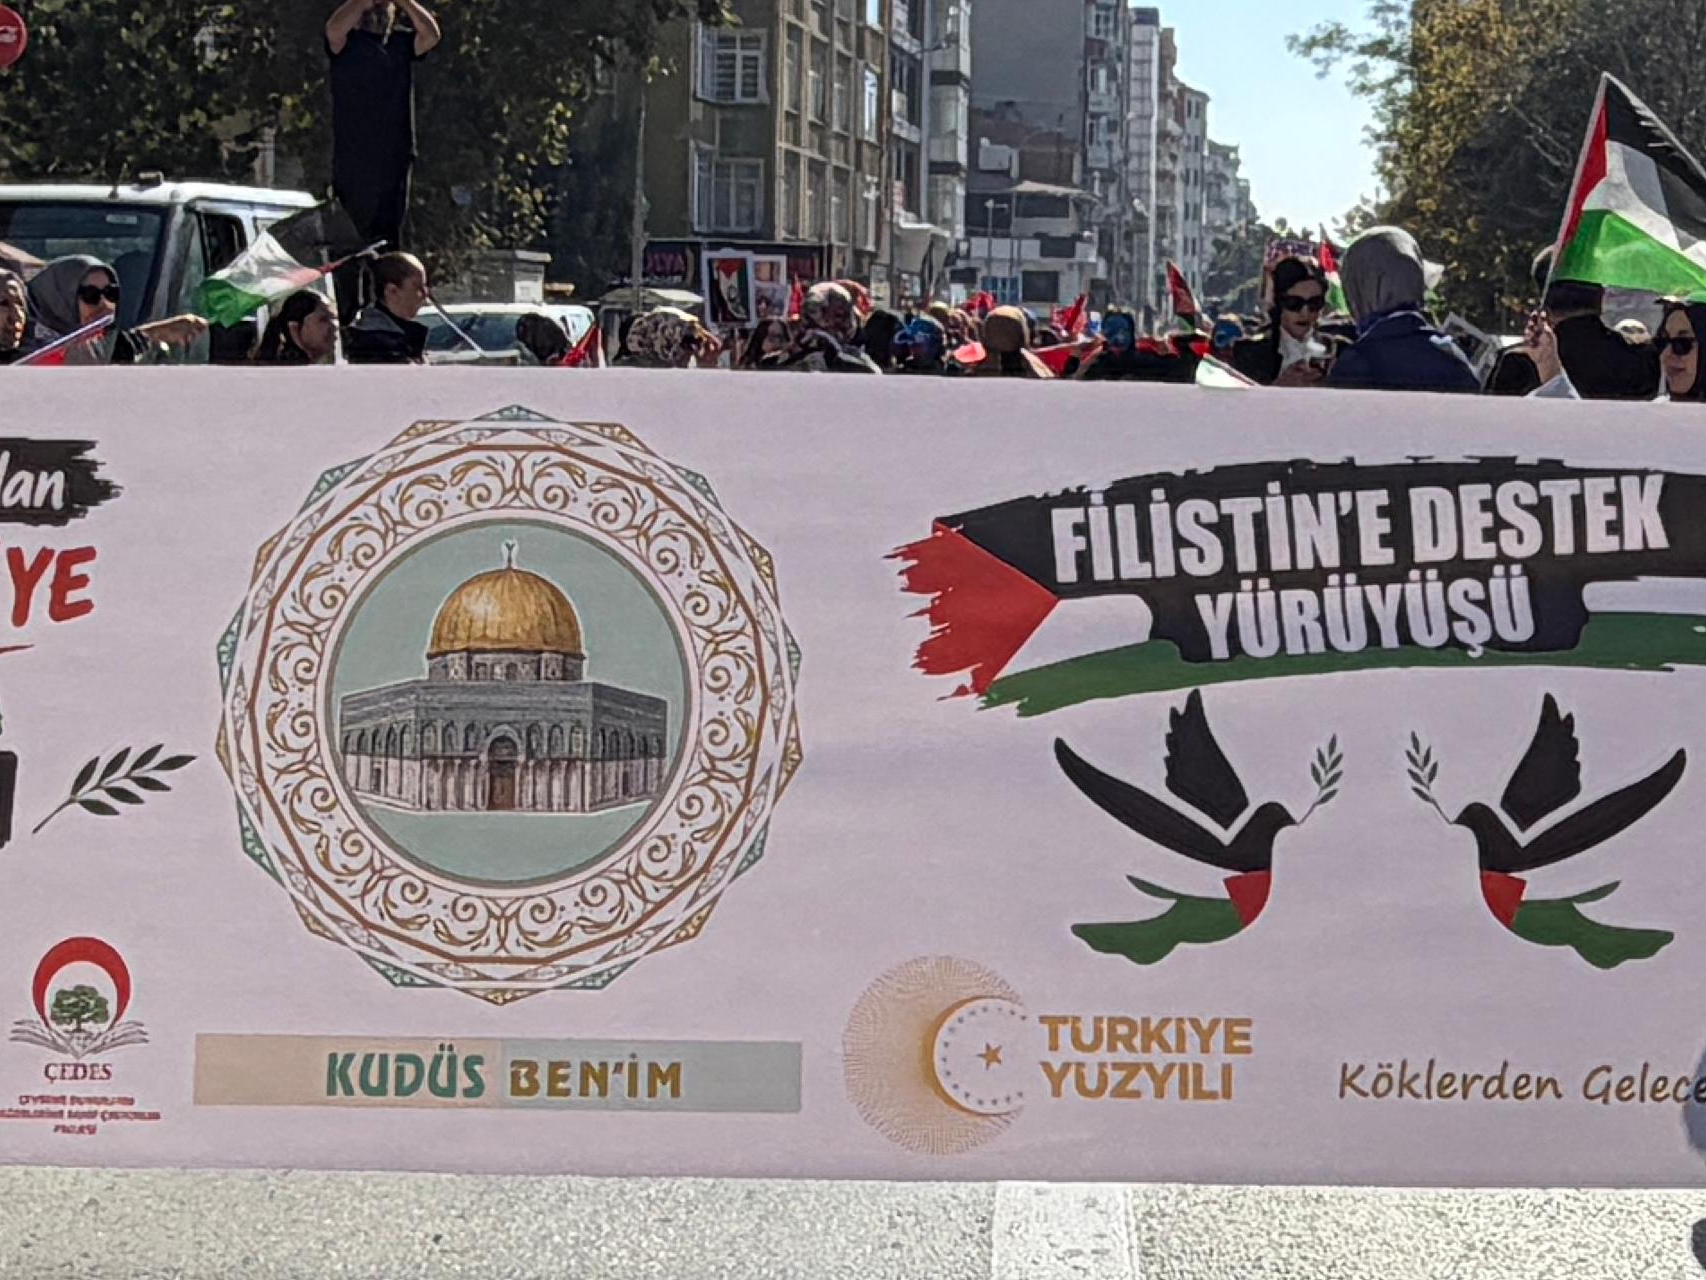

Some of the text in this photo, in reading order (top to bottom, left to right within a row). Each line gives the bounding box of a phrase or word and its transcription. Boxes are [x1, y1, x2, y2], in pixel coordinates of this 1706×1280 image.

[1050, 473, 1670, 584] FİLİSTİN'E DESTEK
[1194, 565, 1537, 659] YÜRÜYÜŞÜ
[44, 1062, 113, 1085] ÇEDES
[325, 1043, 682, 1099] KUDÜS BEN'İM
[1338, 1058, 1563, 1100] Köklerden
